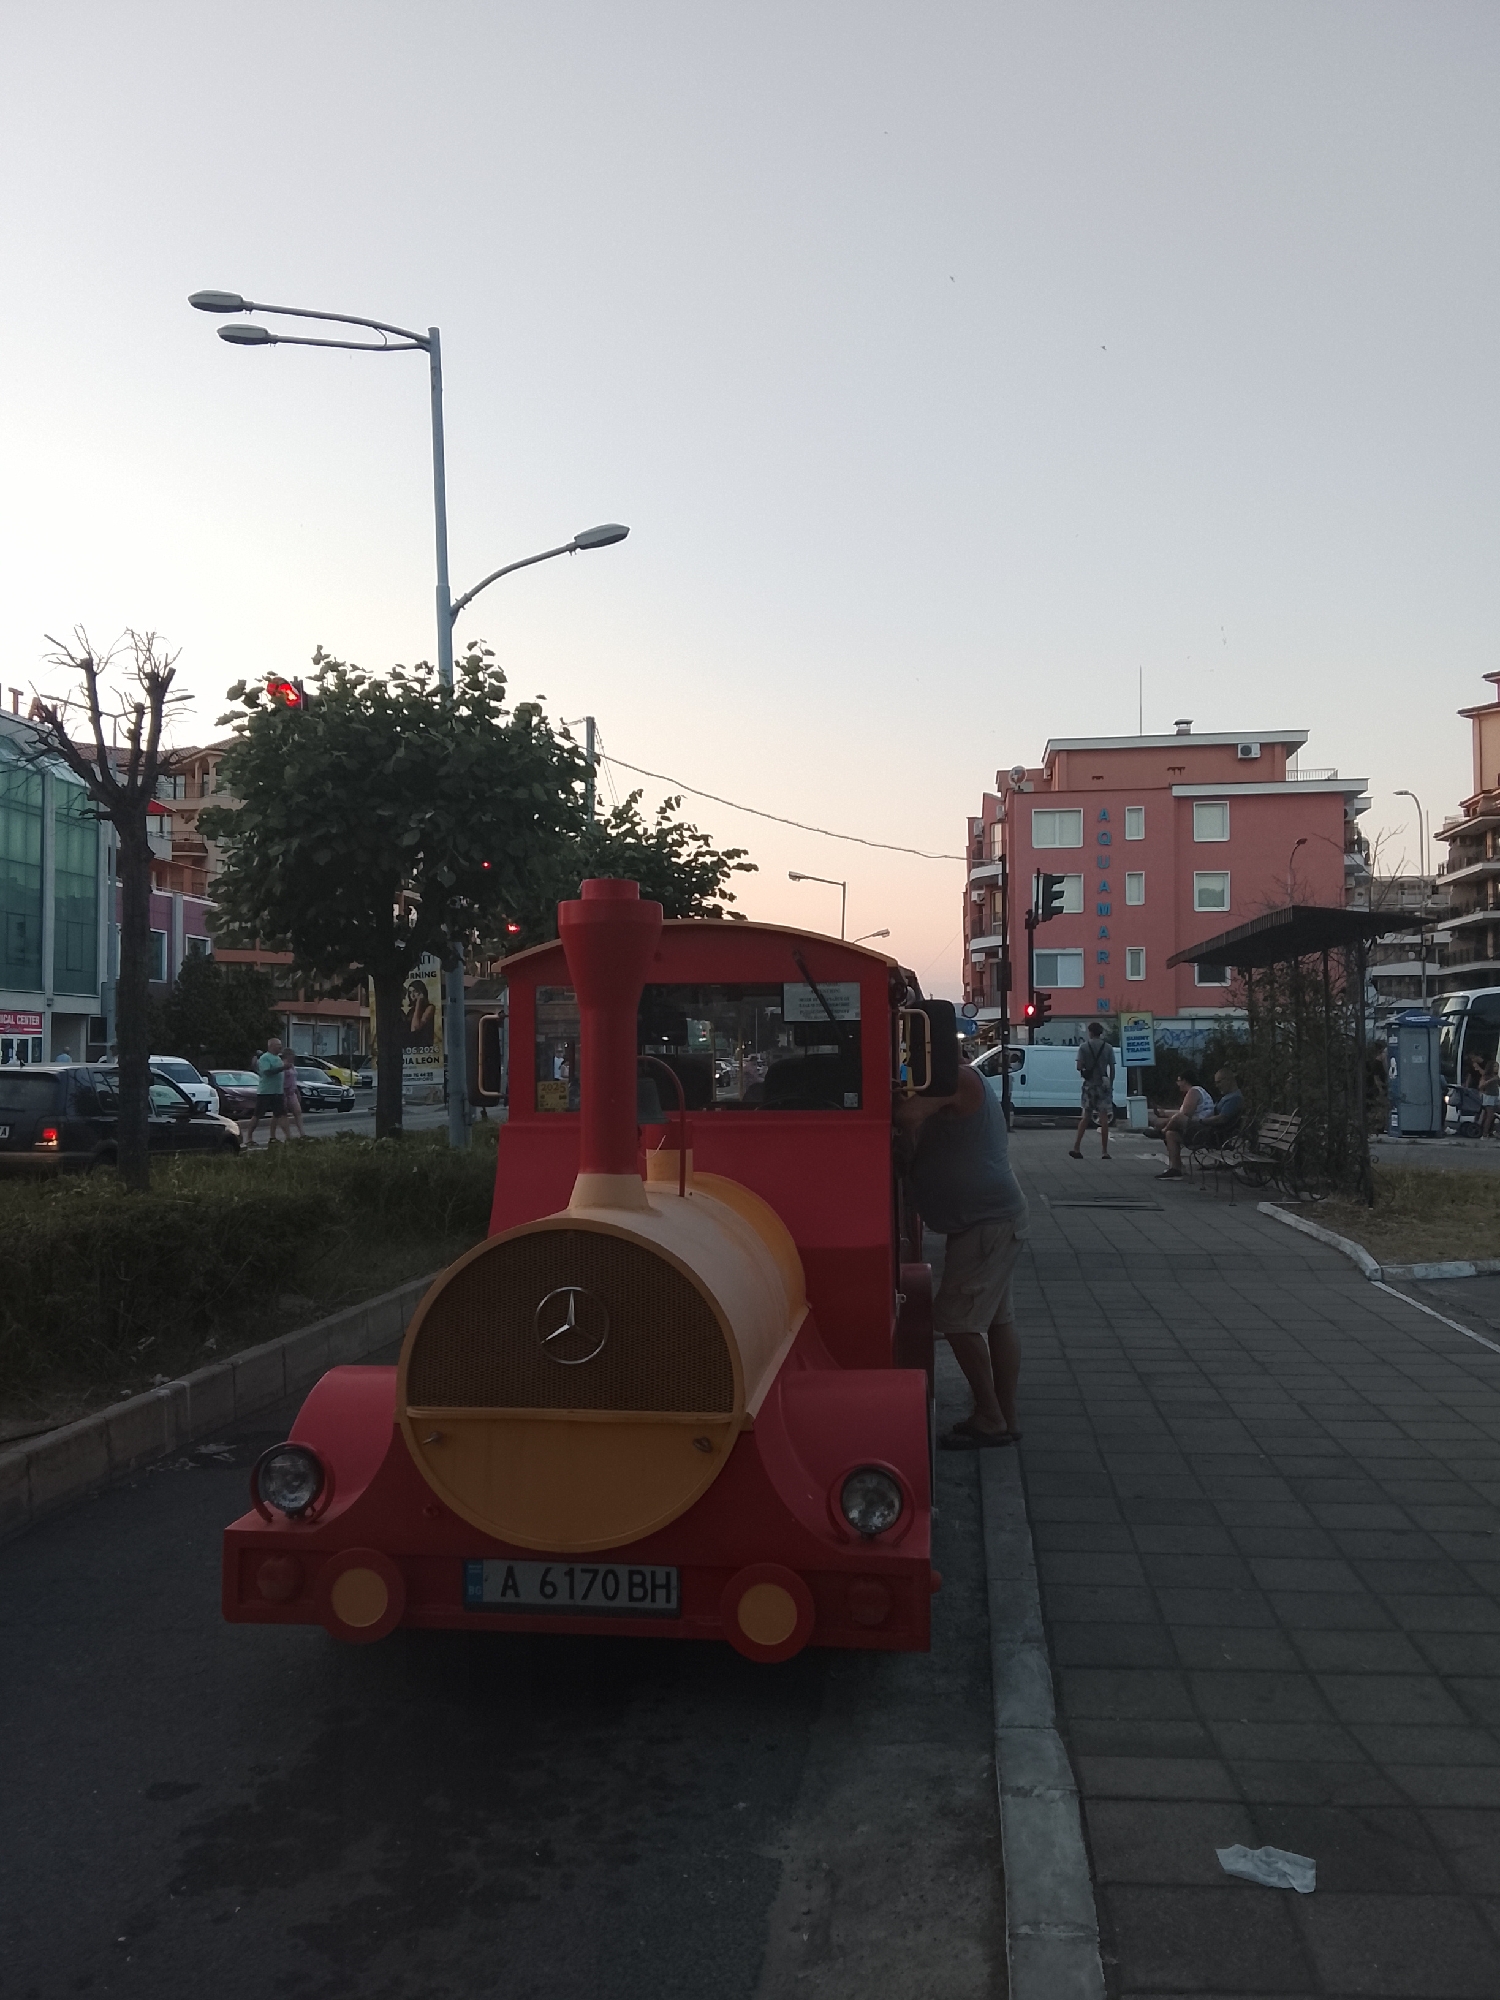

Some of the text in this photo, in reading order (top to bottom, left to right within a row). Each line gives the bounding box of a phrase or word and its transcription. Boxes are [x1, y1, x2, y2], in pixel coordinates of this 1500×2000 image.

[1097, 808, 1112, 1011] AQUAMARIN
[17, 1015, 40, 1025] CENTER
[541, 1082, 566, 1093] 2025
[468, 1586, 482, 1596] BG
[500, 1565, 520, 1598] A
